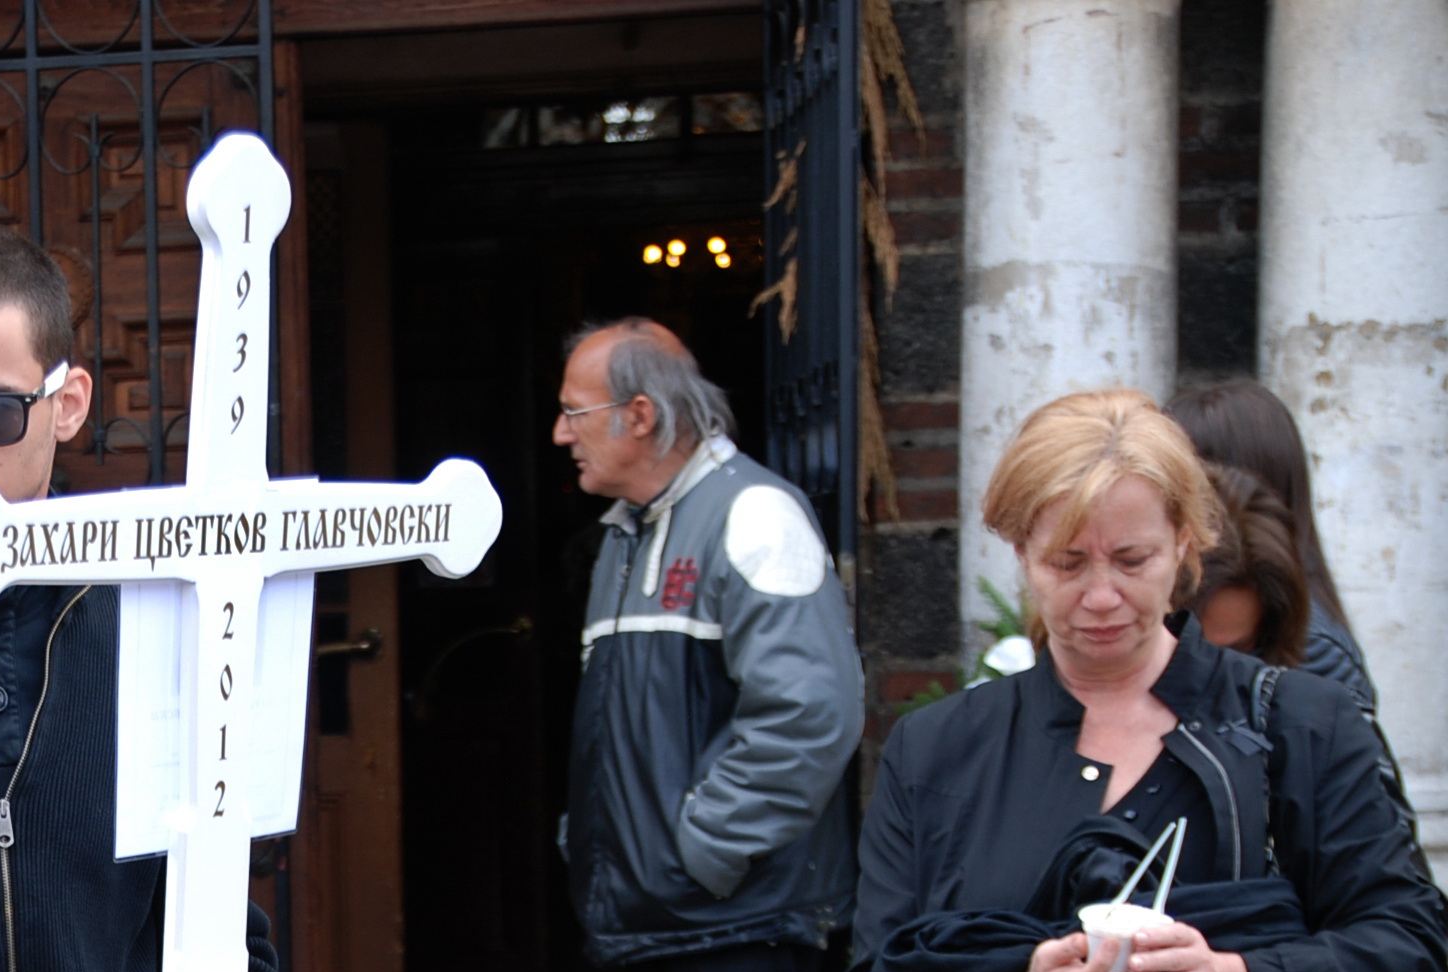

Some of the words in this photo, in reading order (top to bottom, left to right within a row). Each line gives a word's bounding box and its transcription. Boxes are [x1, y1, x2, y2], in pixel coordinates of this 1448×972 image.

[229, 203, 252, 436] 1939
[0, 519, 120, 574] ЗАХАРИ
[279, 502, 453, 553] ГЛАВЧОВСКИ
[212, 600, 236, 819] 2012
